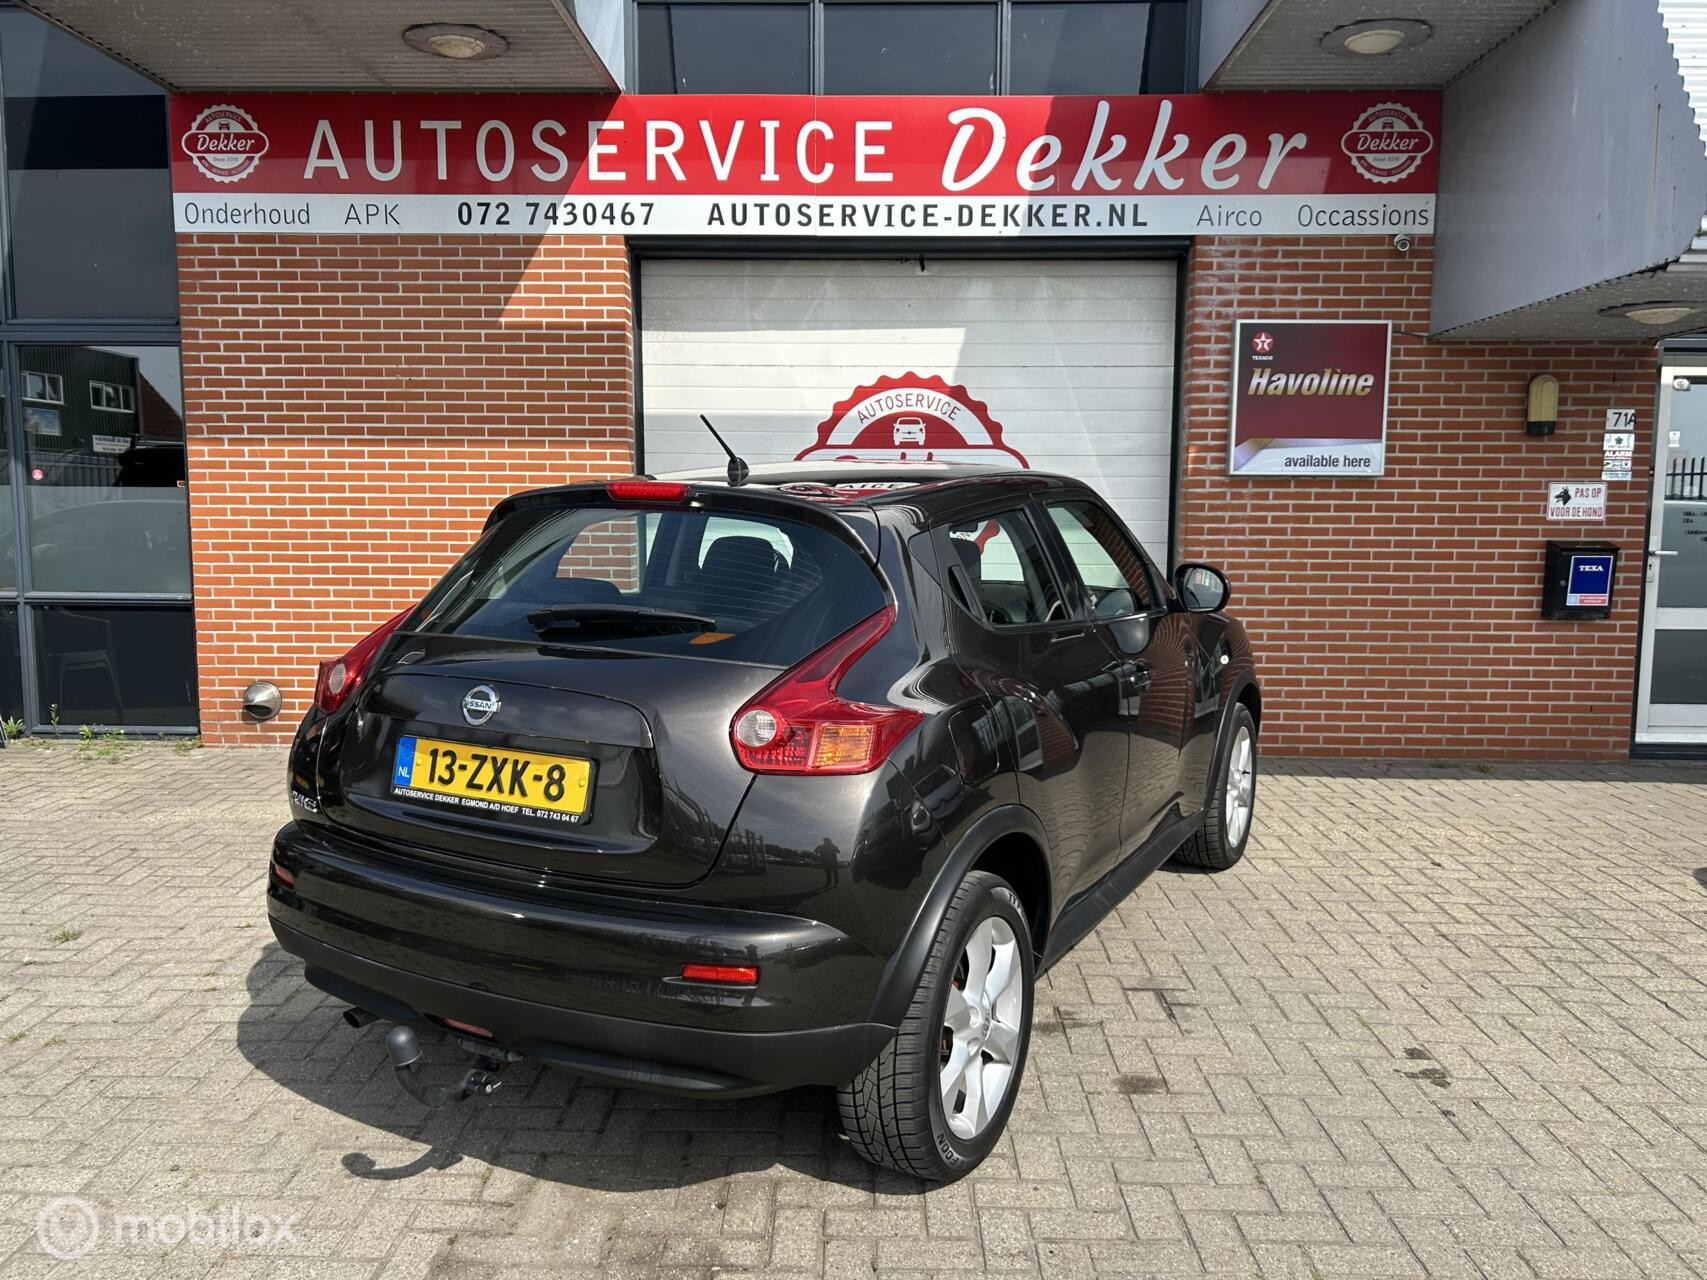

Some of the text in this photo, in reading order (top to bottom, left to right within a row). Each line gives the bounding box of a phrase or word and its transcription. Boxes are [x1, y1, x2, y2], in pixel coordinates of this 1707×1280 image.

[197, 133, 255, 151] Dekker
[303, 99, 1307, 193] AUTOSERVICE Dekker
[1357, 132, 1419, 151] Dekker
[184, 201, 1429, 228] Onderhoud APK 072 7430467 AUTOSERVICE-DEKKER.NL Airco Occassions
[1247, 367, 1375, 396] Havoline
[857, 392, 961, 424] AUTOSERVICE
[1612, 411, 1638, 427] 71A
[1284, 454, 1371, 468] available here
[1575, 487, 1602, 498] PAS OP
[1550, 506, 1603, 517] VOOR DE HOND
[398, 766, 410, 778] NL
[428, 748, 566, 802] 13-ZXK-8
[394, 788, 579, 823] AUTOSERVICE DEKKER EGMOND A/D HOEF TEL. 072 743 04 67
